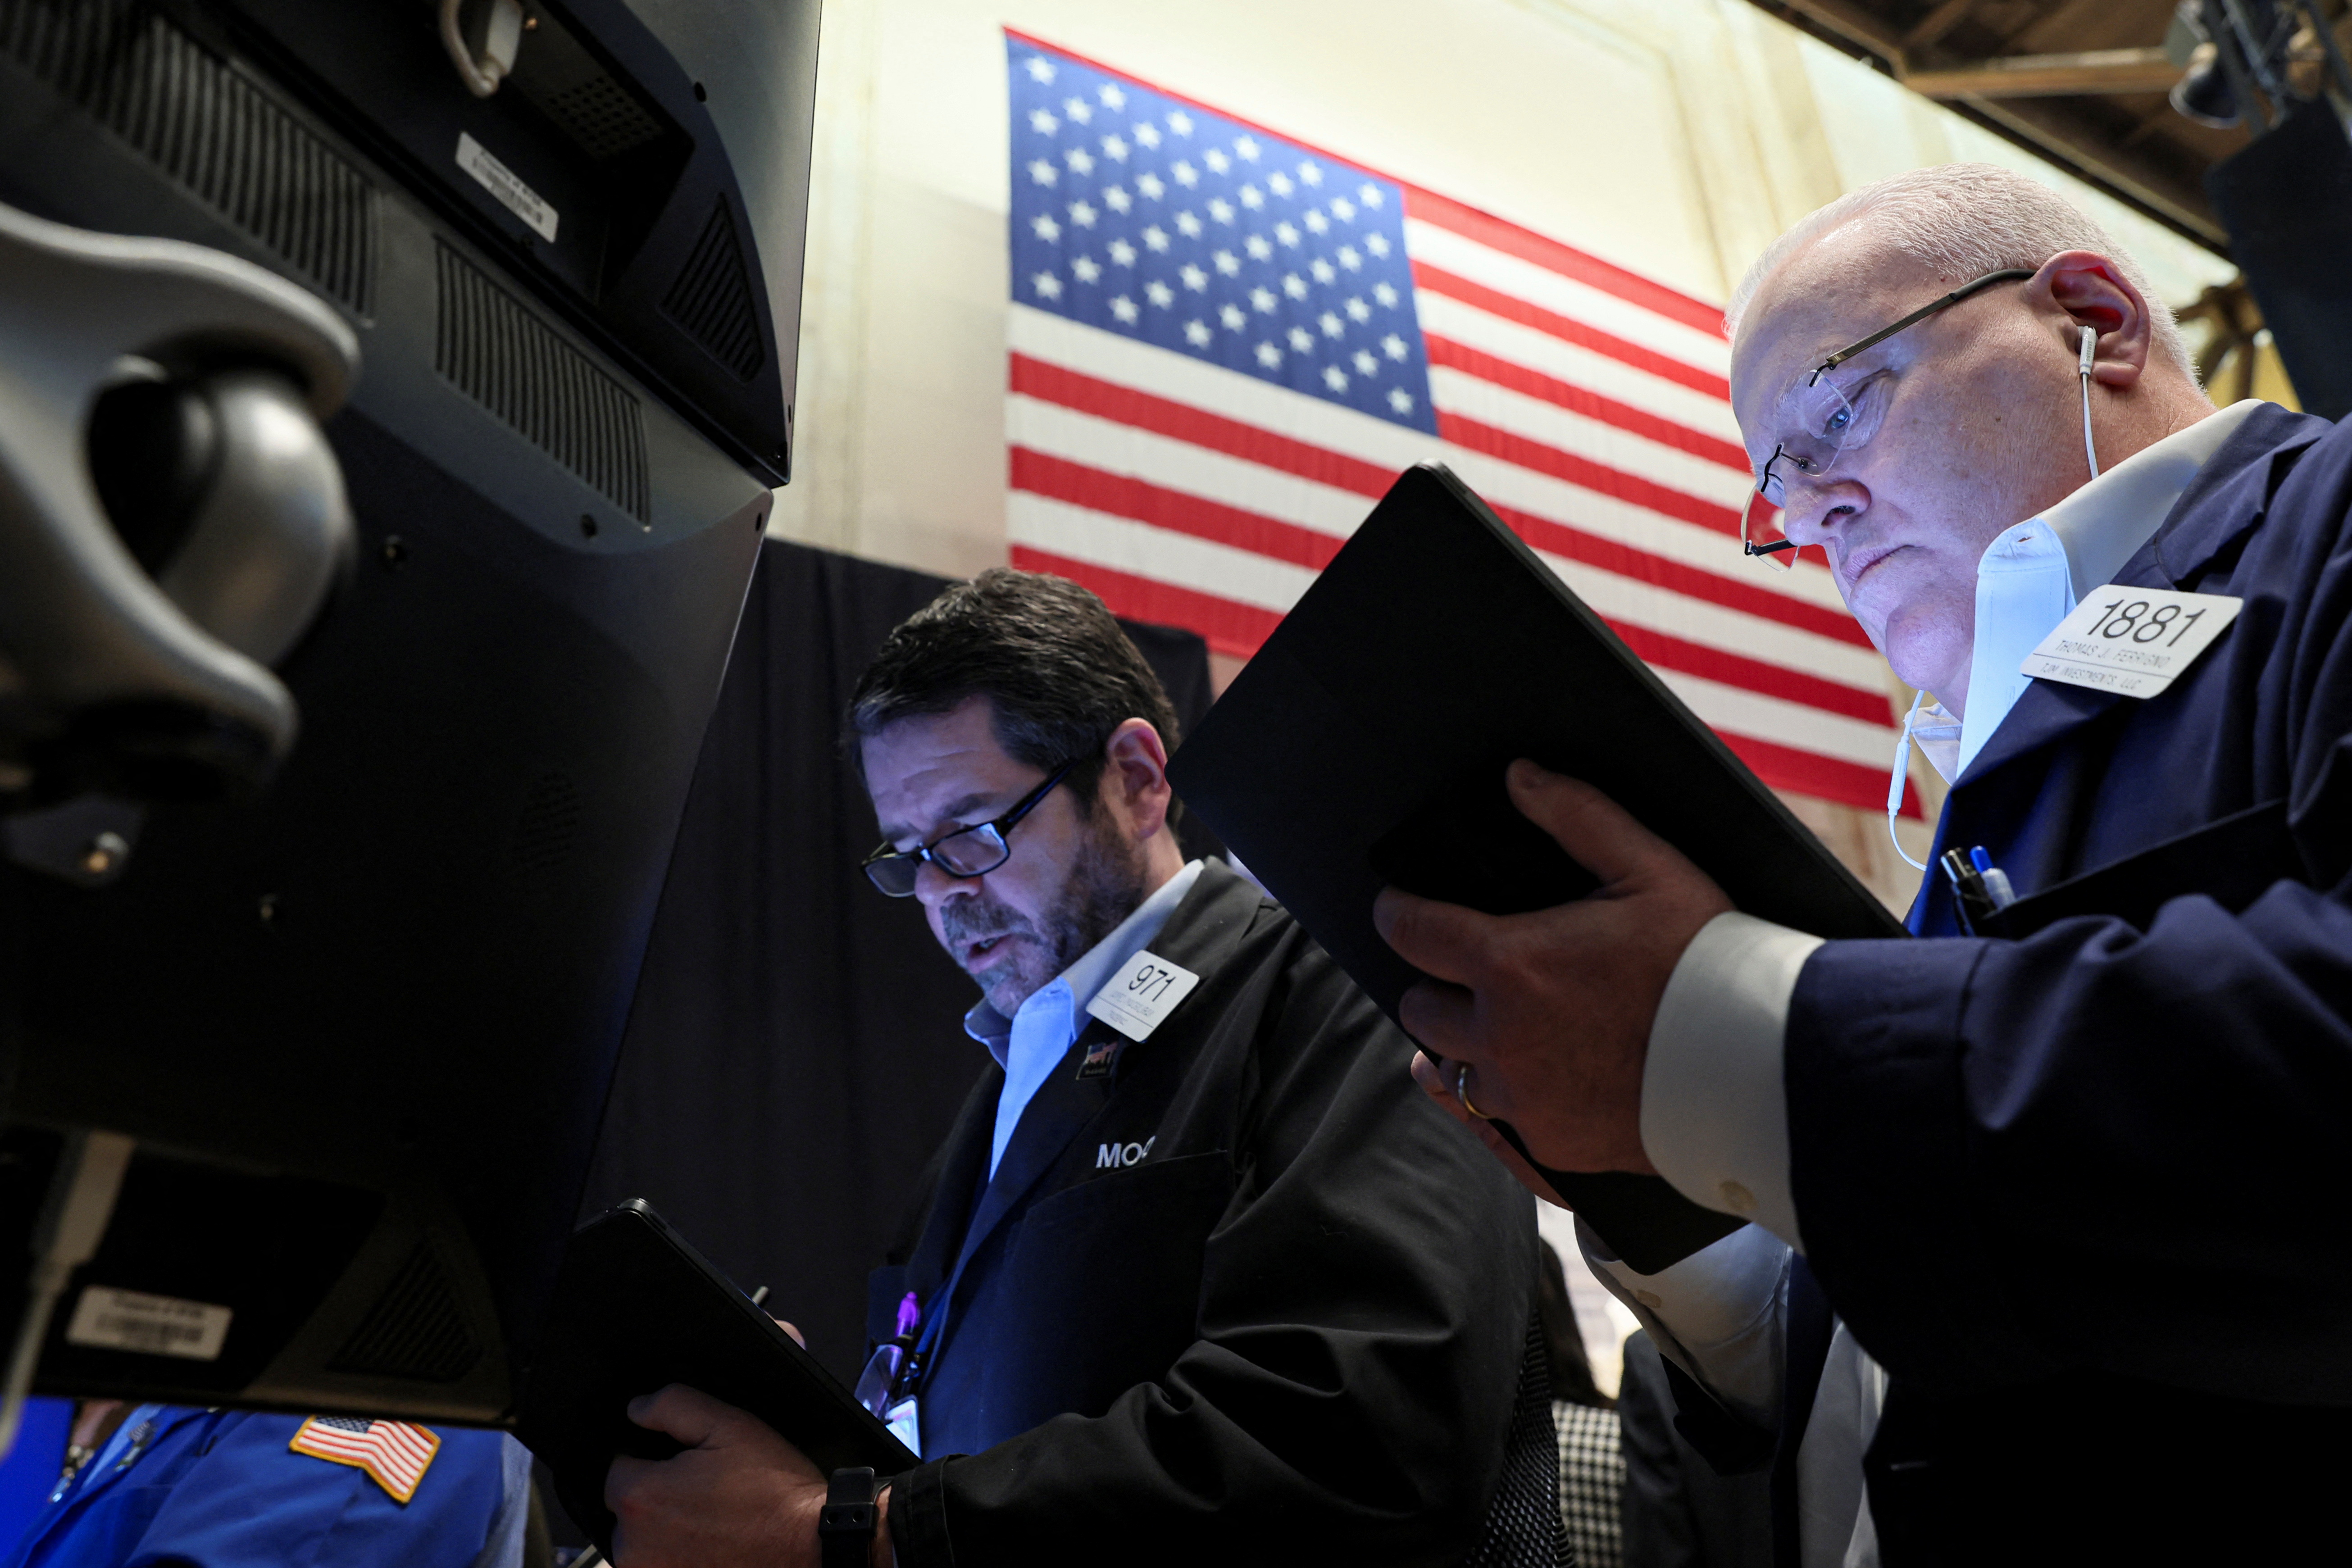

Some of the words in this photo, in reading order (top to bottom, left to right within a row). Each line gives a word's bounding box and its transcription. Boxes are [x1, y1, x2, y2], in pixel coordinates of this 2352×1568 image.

[2088, 599, 2206, 647] 1881
[2055, 640, 2098, 656] THOMAS
[2120, 677, 2141, 690] LLC
[1128, 965, 1176, 1002] 971
